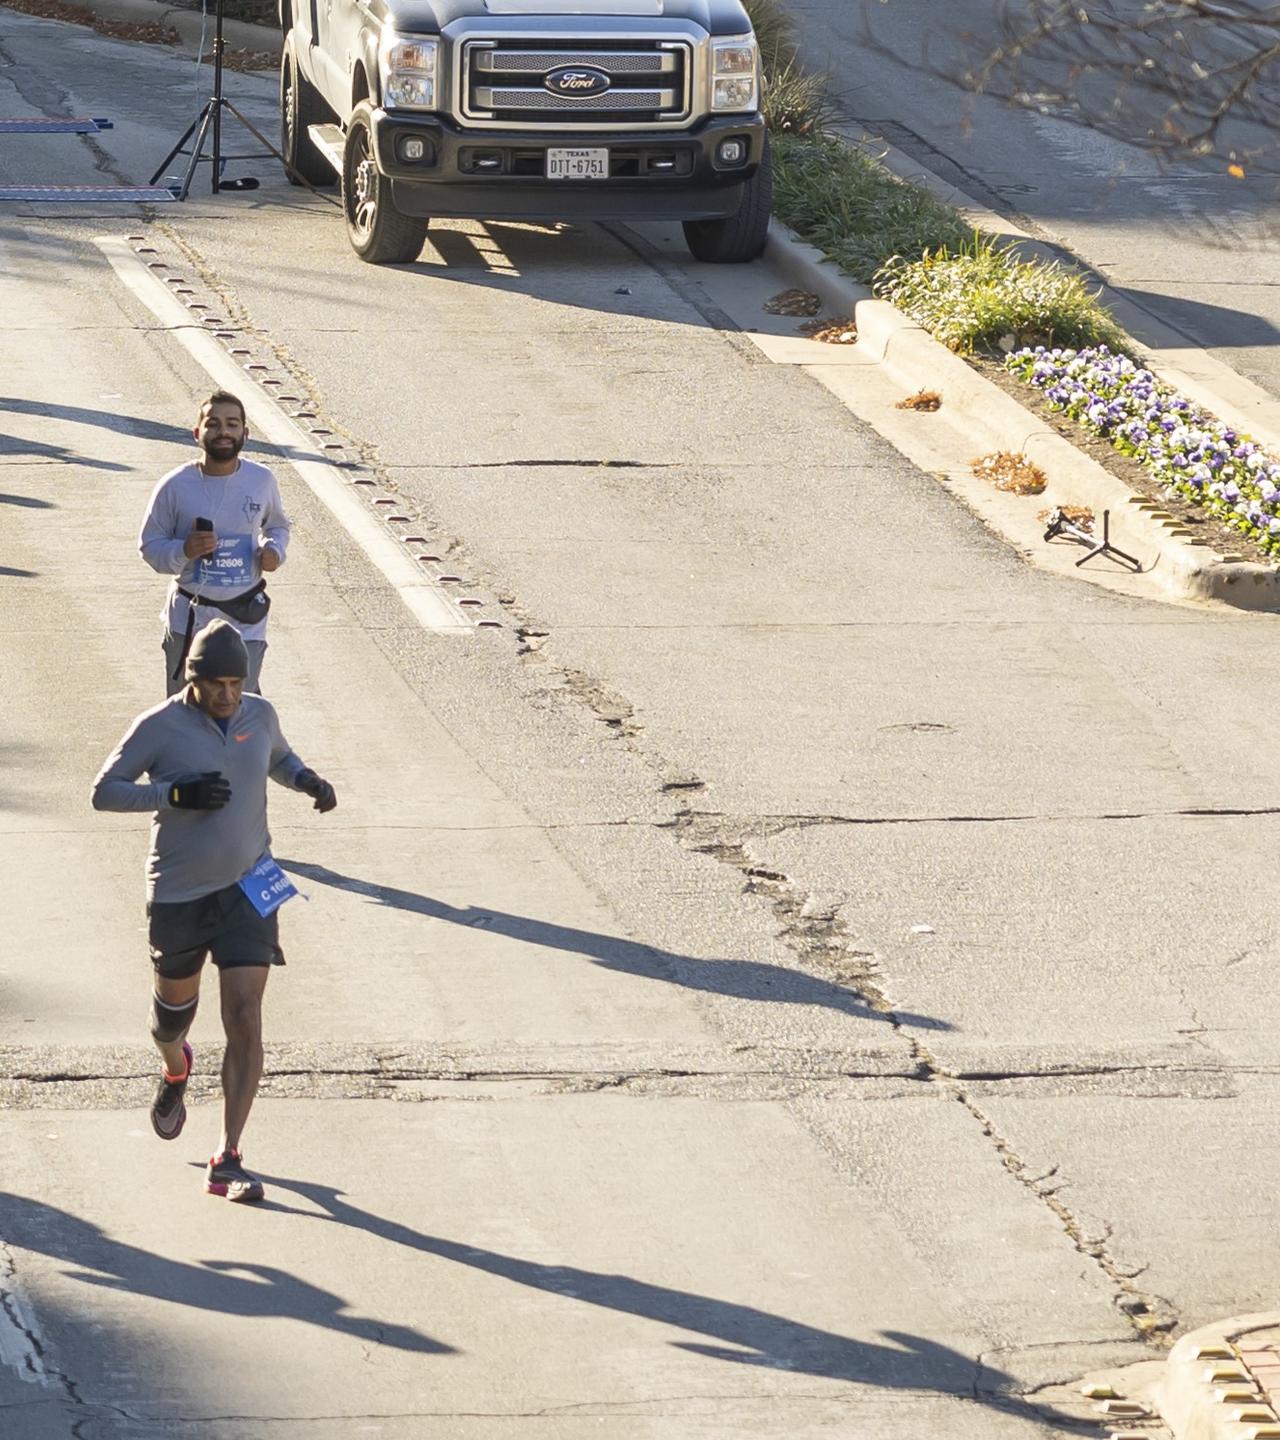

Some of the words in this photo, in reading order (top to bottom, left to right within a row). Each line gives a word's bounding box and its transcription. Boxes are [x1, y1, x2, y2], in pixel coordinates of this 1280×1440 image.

[560, 72, 595, 88] Ford
[551, 160, 604, 173] DTT-6751
[261, 890, 271, 900] C
